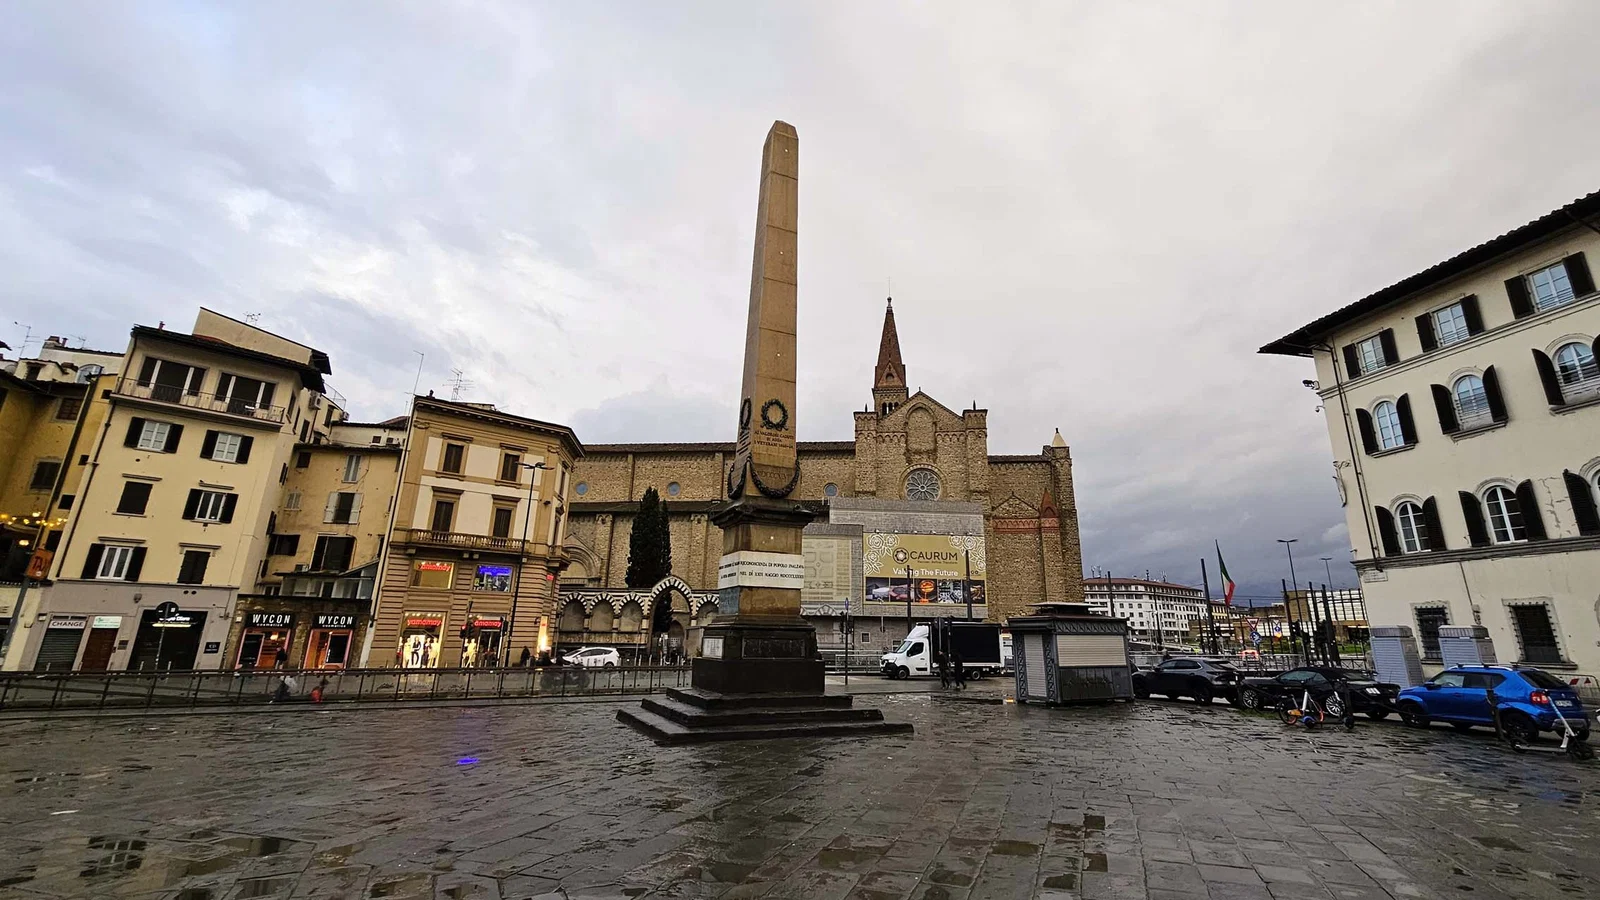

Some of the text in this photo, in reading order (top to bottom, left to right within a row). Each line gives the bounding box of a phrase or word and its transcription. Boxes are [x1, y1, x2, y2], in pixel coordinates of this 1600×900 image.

[910, 551, 958, 561] CAURUM
[892, 567, 959, 577] Valung The Future
[51, 620, 84, 628] CHANGE
[252, 614, 291, 624] WYCON
[318, 615, 353, 625] WYCON
[407, 618, 441, 627] yamamay
[473, 619, 502, 628] amamay
